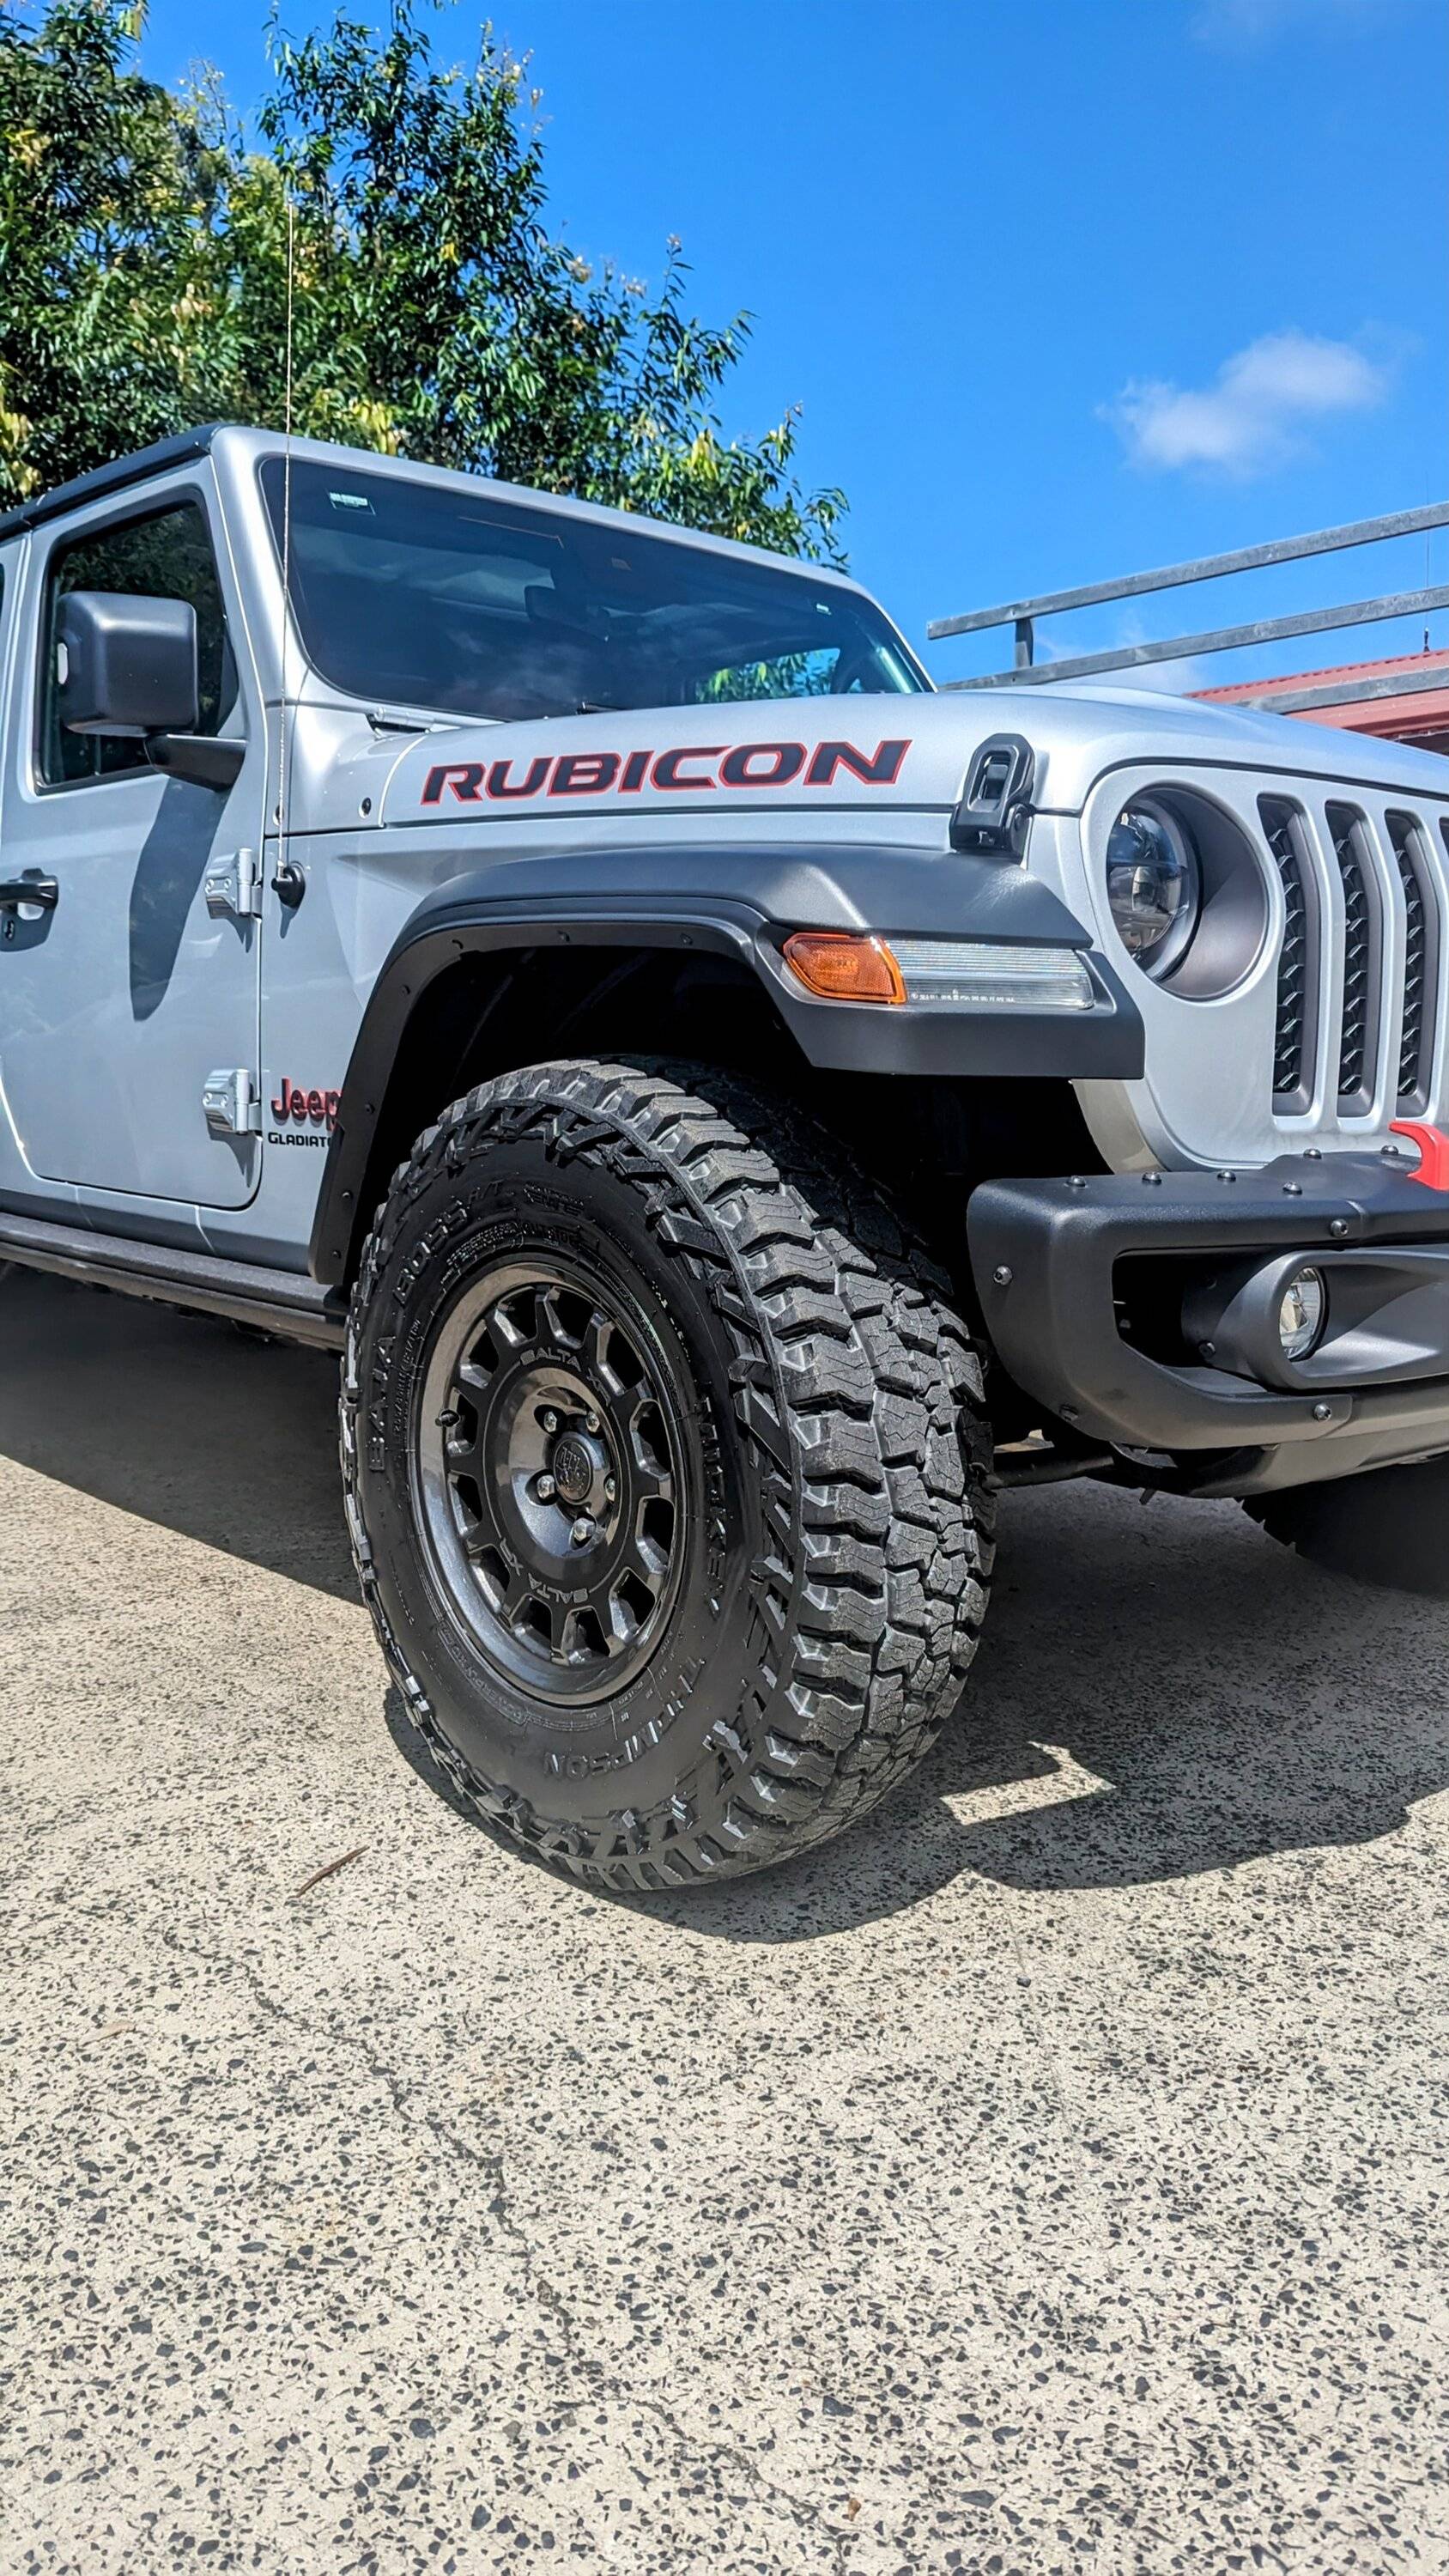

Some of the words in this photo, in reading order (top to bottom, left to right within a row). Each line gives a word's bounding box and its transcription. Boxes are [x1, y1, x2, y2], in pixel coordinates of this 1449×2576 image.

[421, 739, 912, 805] RUBICON
[270, 1076, 344, 1132] Jeep
[268, 1131, 331, 1149] GLADIAT
